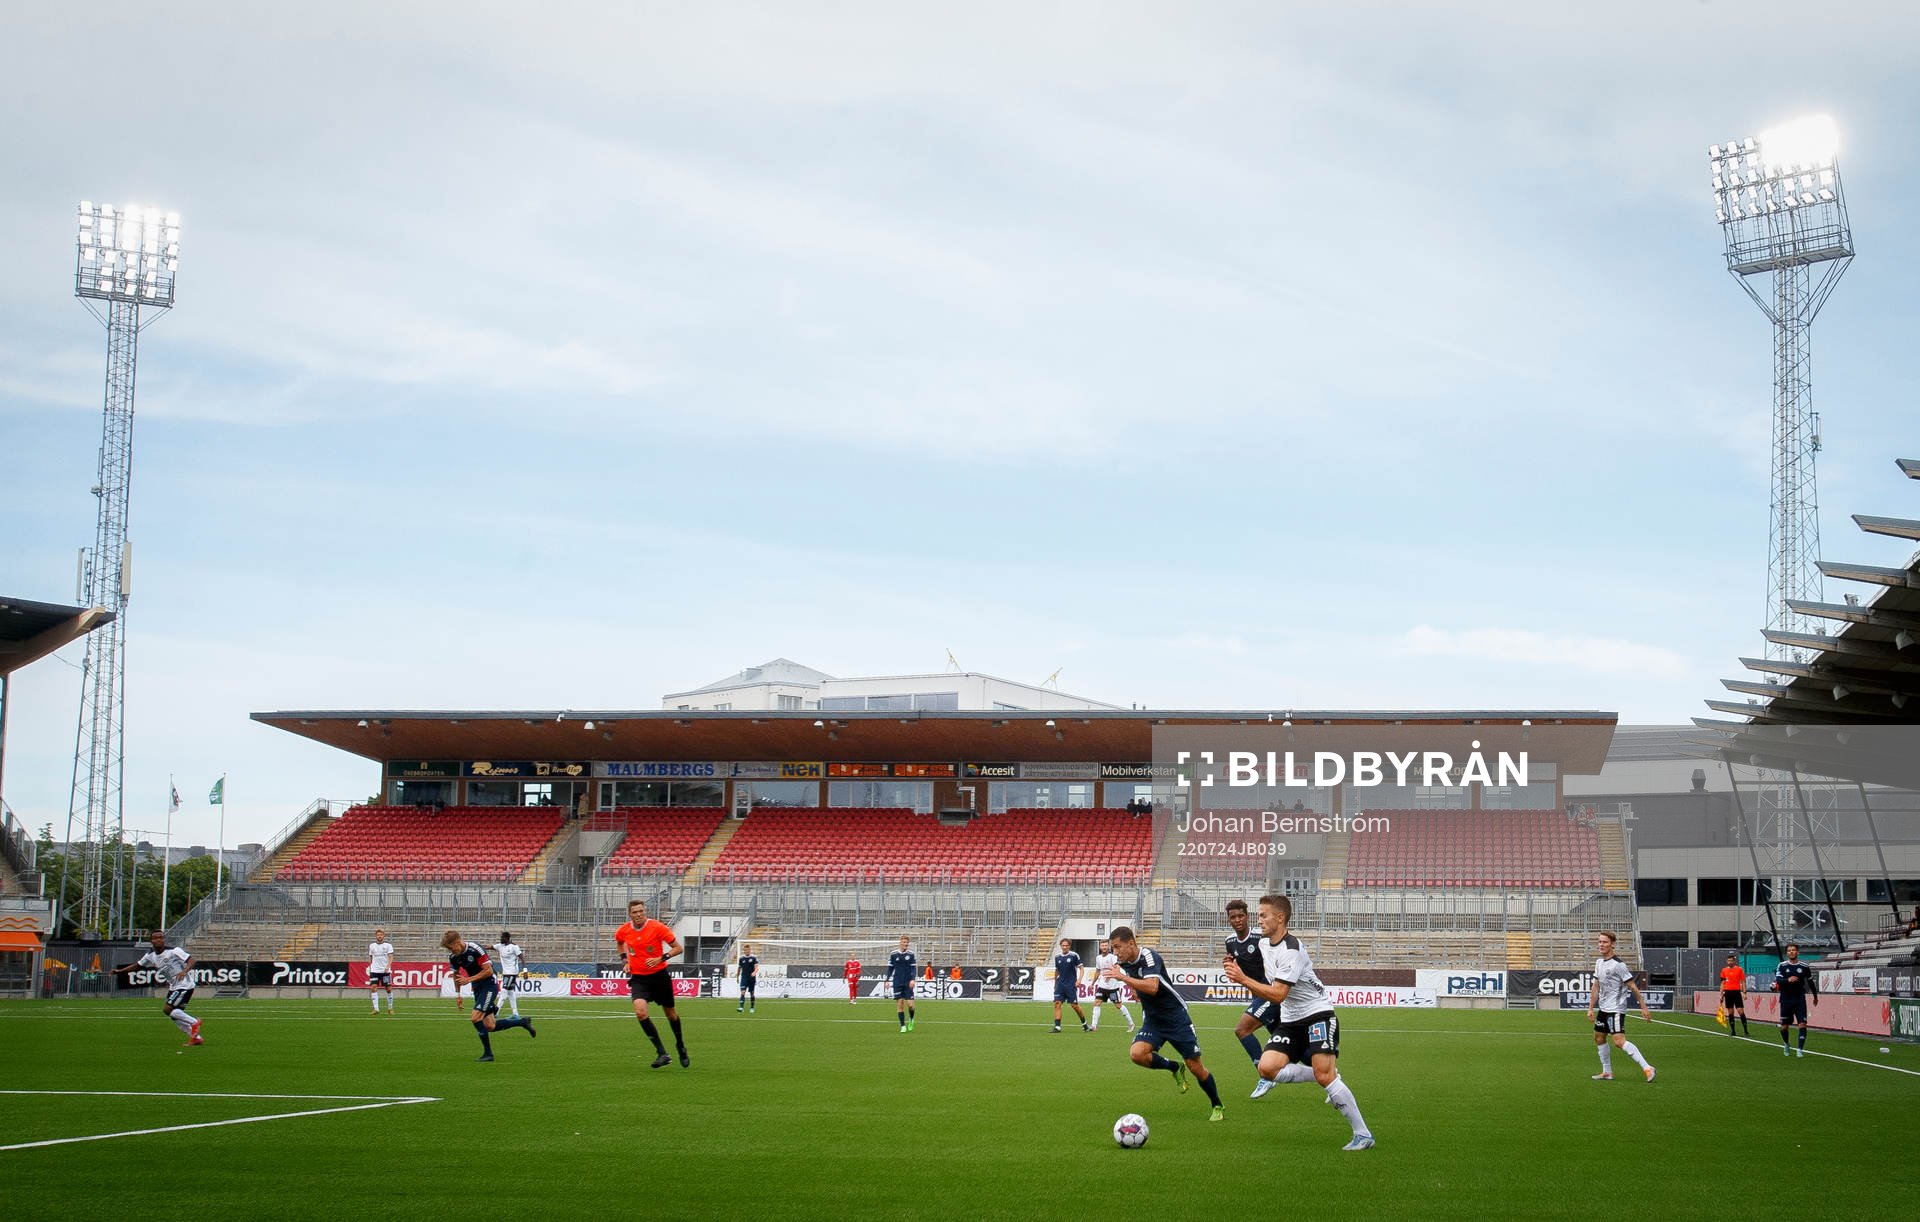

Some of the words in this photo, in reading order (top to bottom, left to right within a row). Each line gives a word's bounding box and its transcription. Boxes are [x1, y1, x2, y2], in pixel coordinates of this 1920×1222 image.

[607, 763, 715, 777] MALMBERGS
[981, 765, 1015, 777] Accesit
[1102, 765, 1176, 776] Mobilverkstan
[273, 962, 346, 985] Printoz
[1171, 974, 1206, 983] ICON
[796, 979, 826, 989] MEDIA
[1447, 973, 1503, 994] pahl
